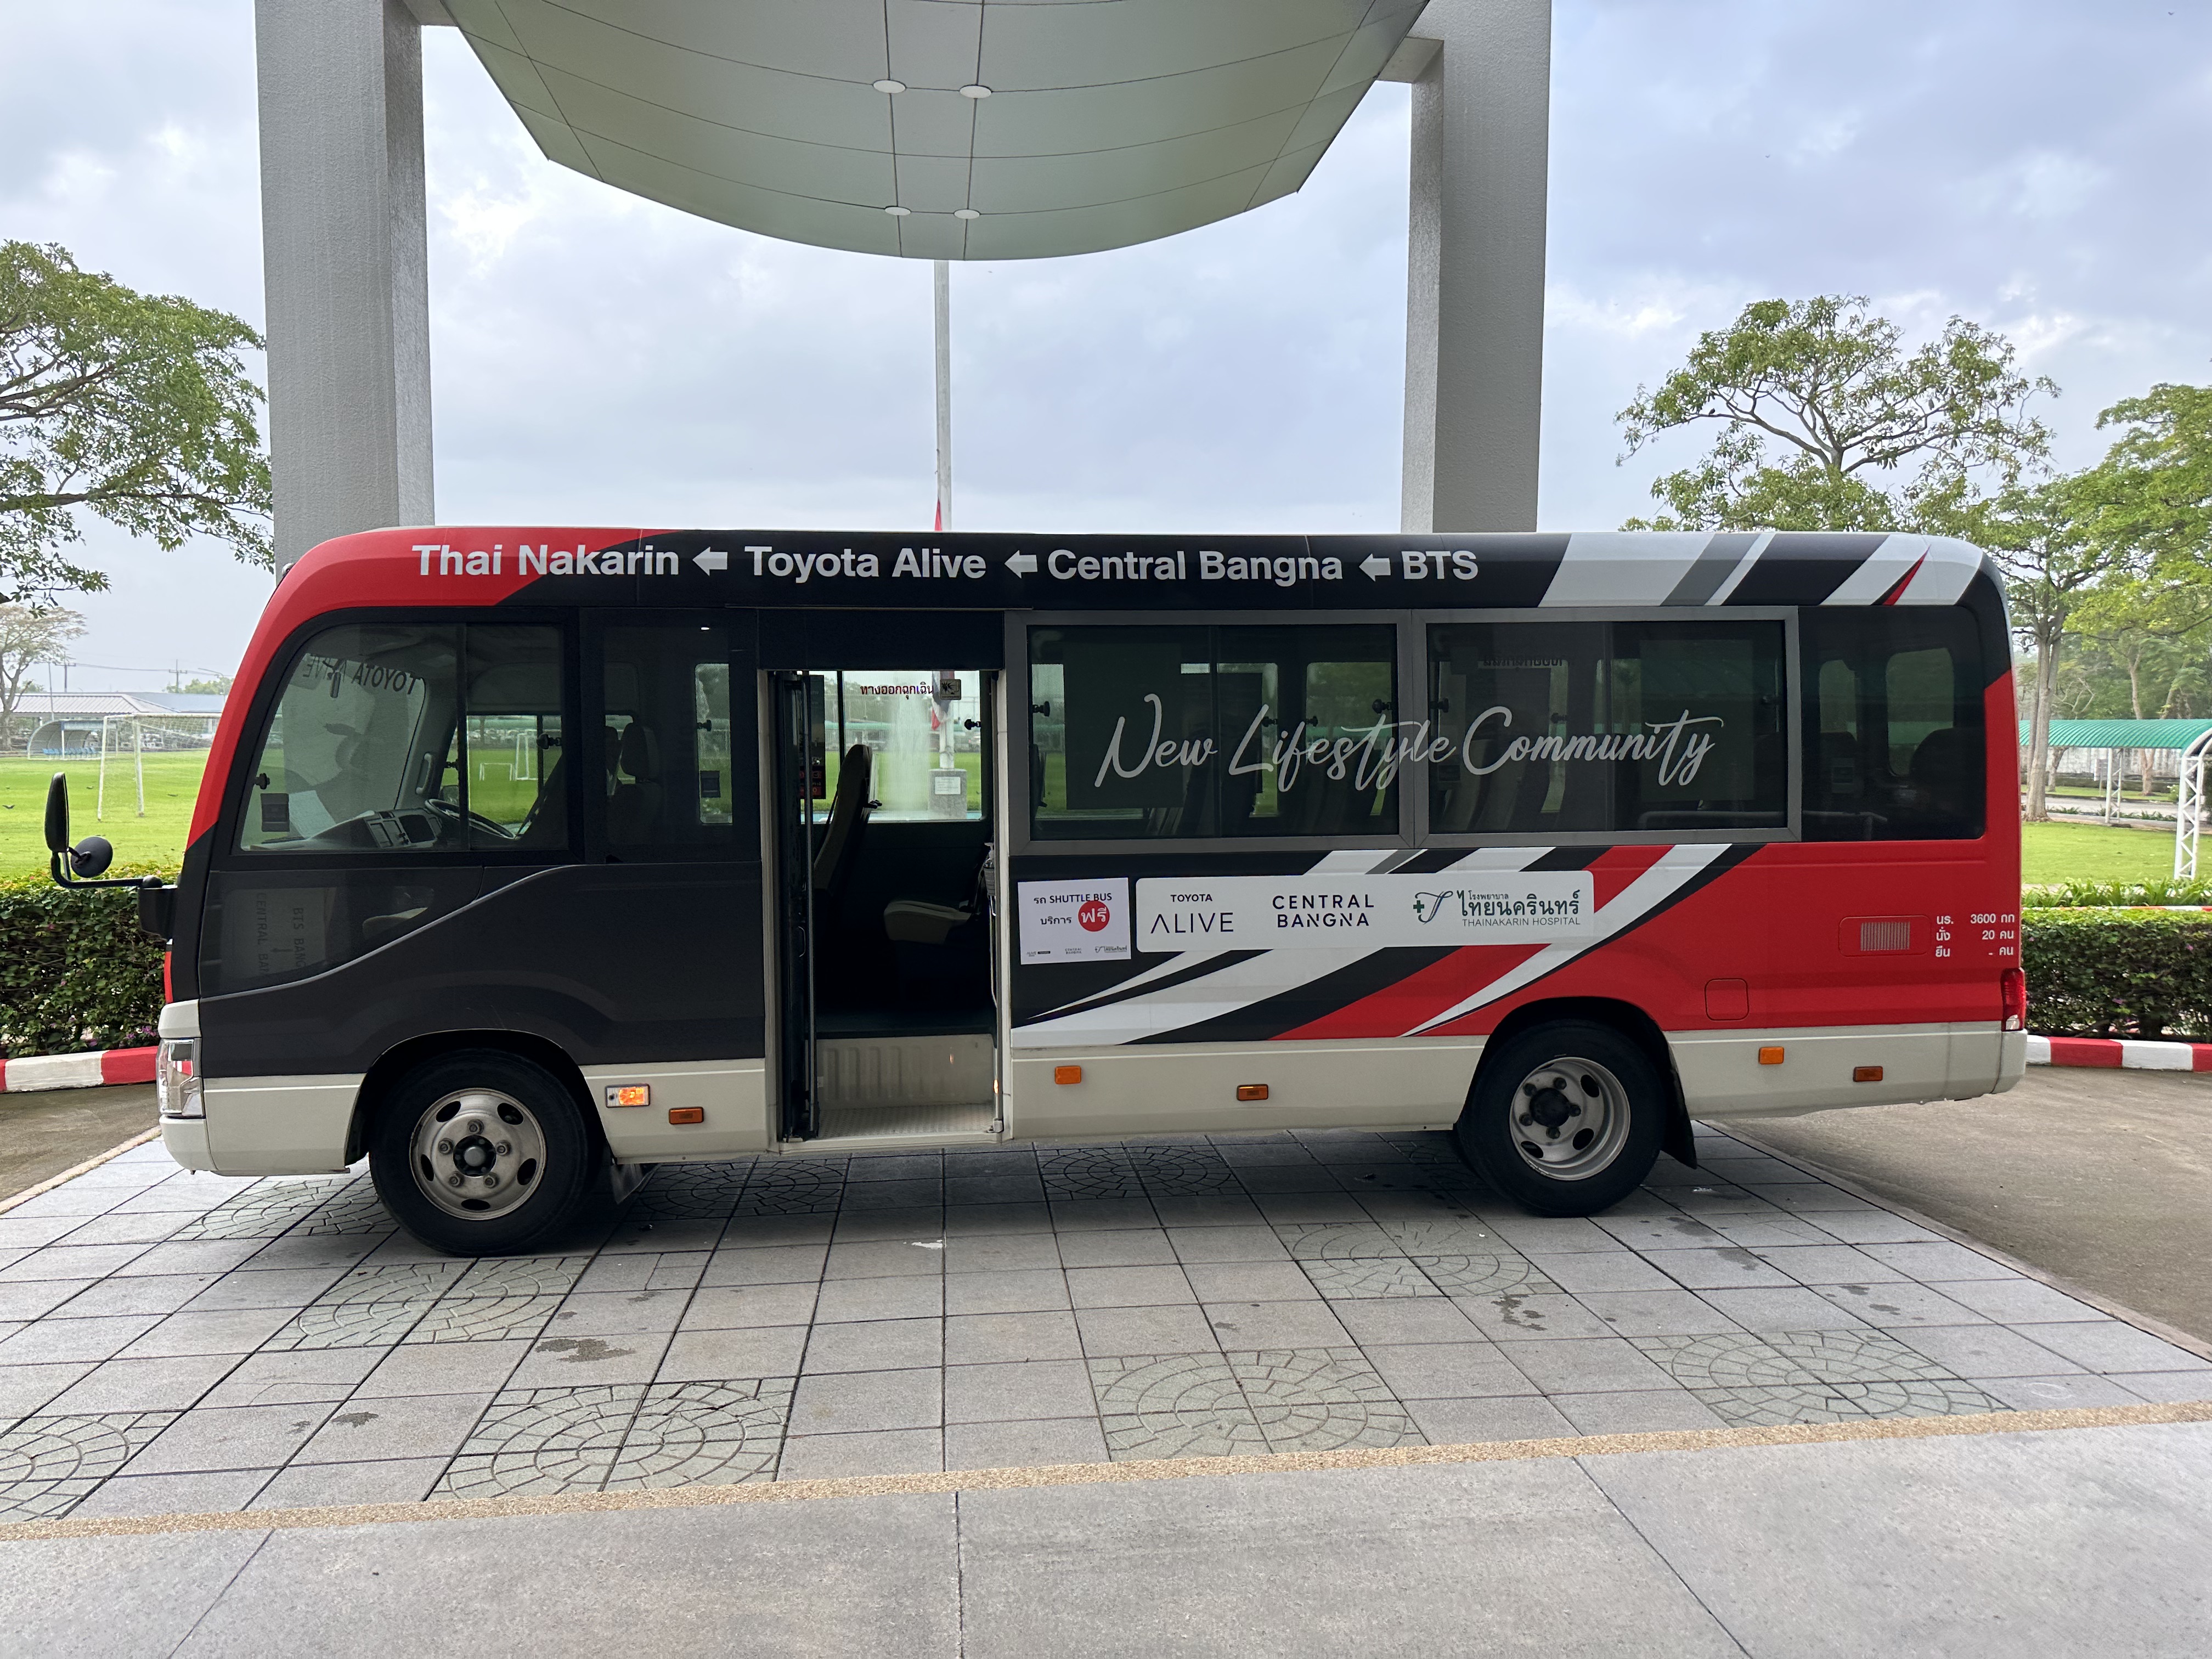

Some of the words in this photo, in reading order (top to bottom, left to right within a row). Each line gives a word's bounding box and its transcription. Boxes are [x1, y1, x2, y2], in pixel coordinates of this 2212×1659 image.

[411, 544, 503, 575] Thai
[519, 544, 679, 575] Nakarin
[744, 546, 879, 583] Toyota
[891, 548, 987, 578] Alive
[1048, 549, 1186, 579] Central
[1199, 550, 1343, 587] Bangna
[1402, 550, 1479, 580] BTS
[860, 681, 934, 699] ทางออกฉุกเฉิน
[1094, 693, 1218, 788] New
[1228, 704, 1458, 792] Lifestyle
[1462, 706, 1724, 786] Community
[1049, 894, 1091, 904] SHUTTLE
[1093, 893, 1112, 901] BUS
[1171, 894, 1213, 902] TOYOTA
[1272, 894, 1374, 910] CENTRAL
[1457, 889, 1581, 916] ไทยนครินทร์
[1468, 890, 1509, 900] โรงพยาบาล
[1040, 916, 1072, 925] บริการ
[1081, 907, 1107, 923] ฟรี
[1150, 912, 1234, 934] ALIVE
[1277, 912, 1369, 928] BANGNA
[1462, 918, 1529, 927] THAINAKARIN
[1532, 917, 1581, 926] HOSPITAL
[1970, 913, 1996, 924] 3600
[2001, 914, 2015, 923] กก
[1936, 927, 1951, 941] นั่ง
[1982, 930, 1995, 940] 20
[2000, 930, 2014, 939] คน
[1935, 945, 1950, 957] ยืน
[1999, 947, 2013, 956] คน
